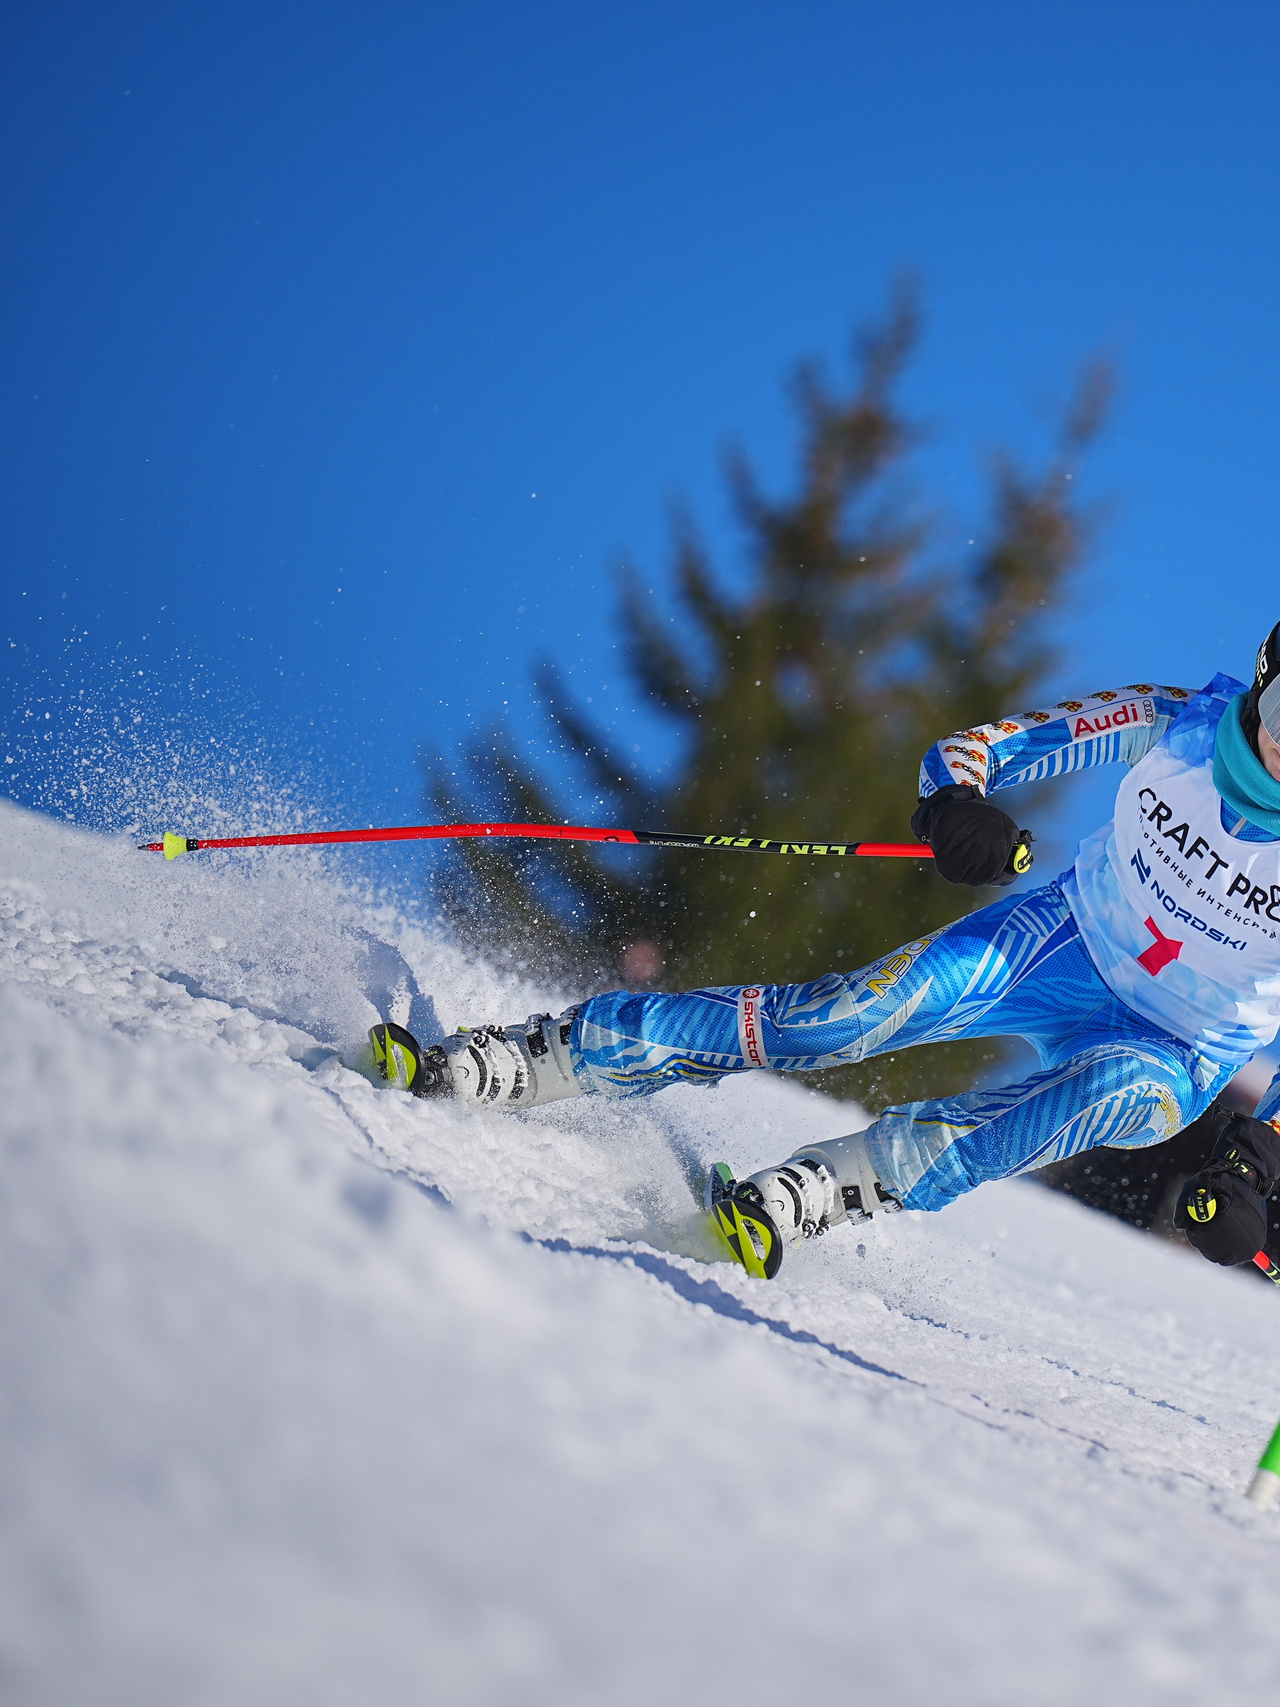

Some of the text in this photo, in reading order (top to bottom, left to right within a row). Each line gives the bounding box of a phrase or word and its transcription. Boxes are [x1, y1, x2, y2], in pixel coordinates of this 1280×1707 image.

[1074, 703, 1139, 737] Audi
[780, 844, 847, 855] LEKI
[1138, 787, 1229, 880] CRAFT
[1150, 879, 1248, 951] NORDSKI
[1197, 1196, 1206, 1219] LEKI
